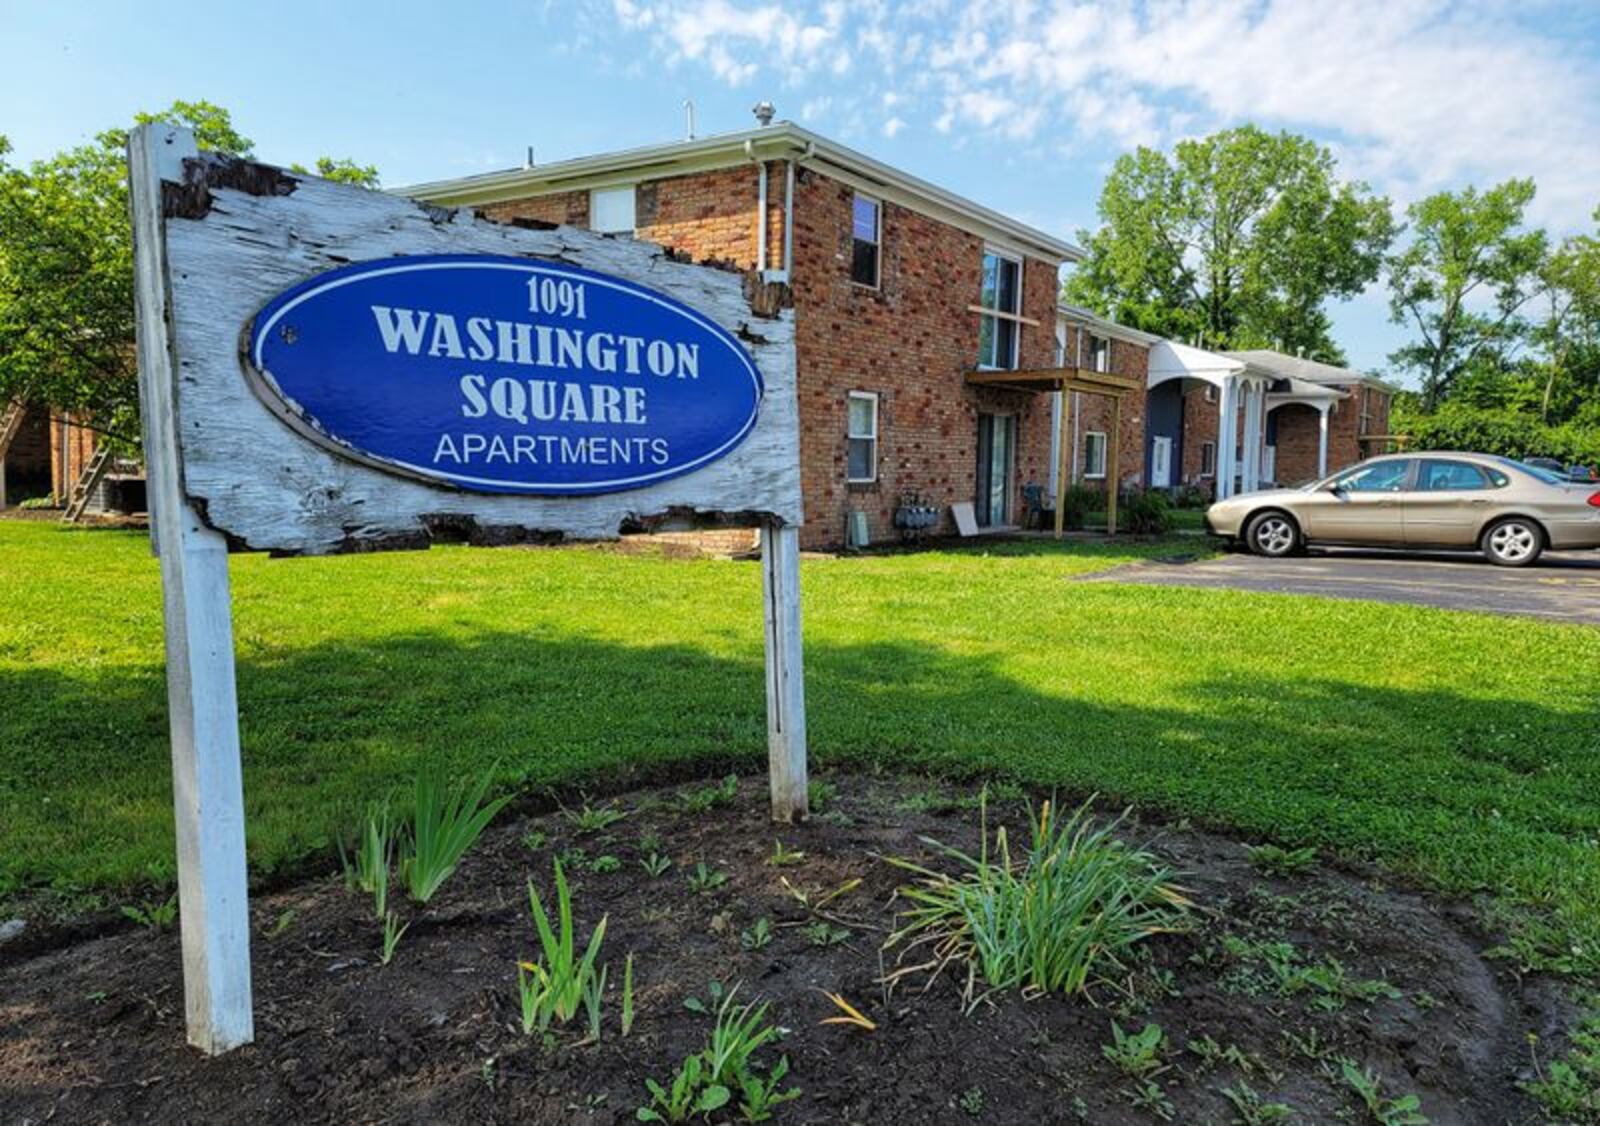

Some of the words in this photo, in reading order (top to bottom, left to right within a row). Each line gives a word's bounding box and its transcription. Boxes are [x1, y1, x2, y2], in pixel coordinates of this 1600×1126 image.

[527, 276, 586, 319] 1091
[371, 306, 699, 379] WASHINGTON
[460, 375, 647, 424] SQUARE
[433, 434, 669, 465] APARTMENTS
